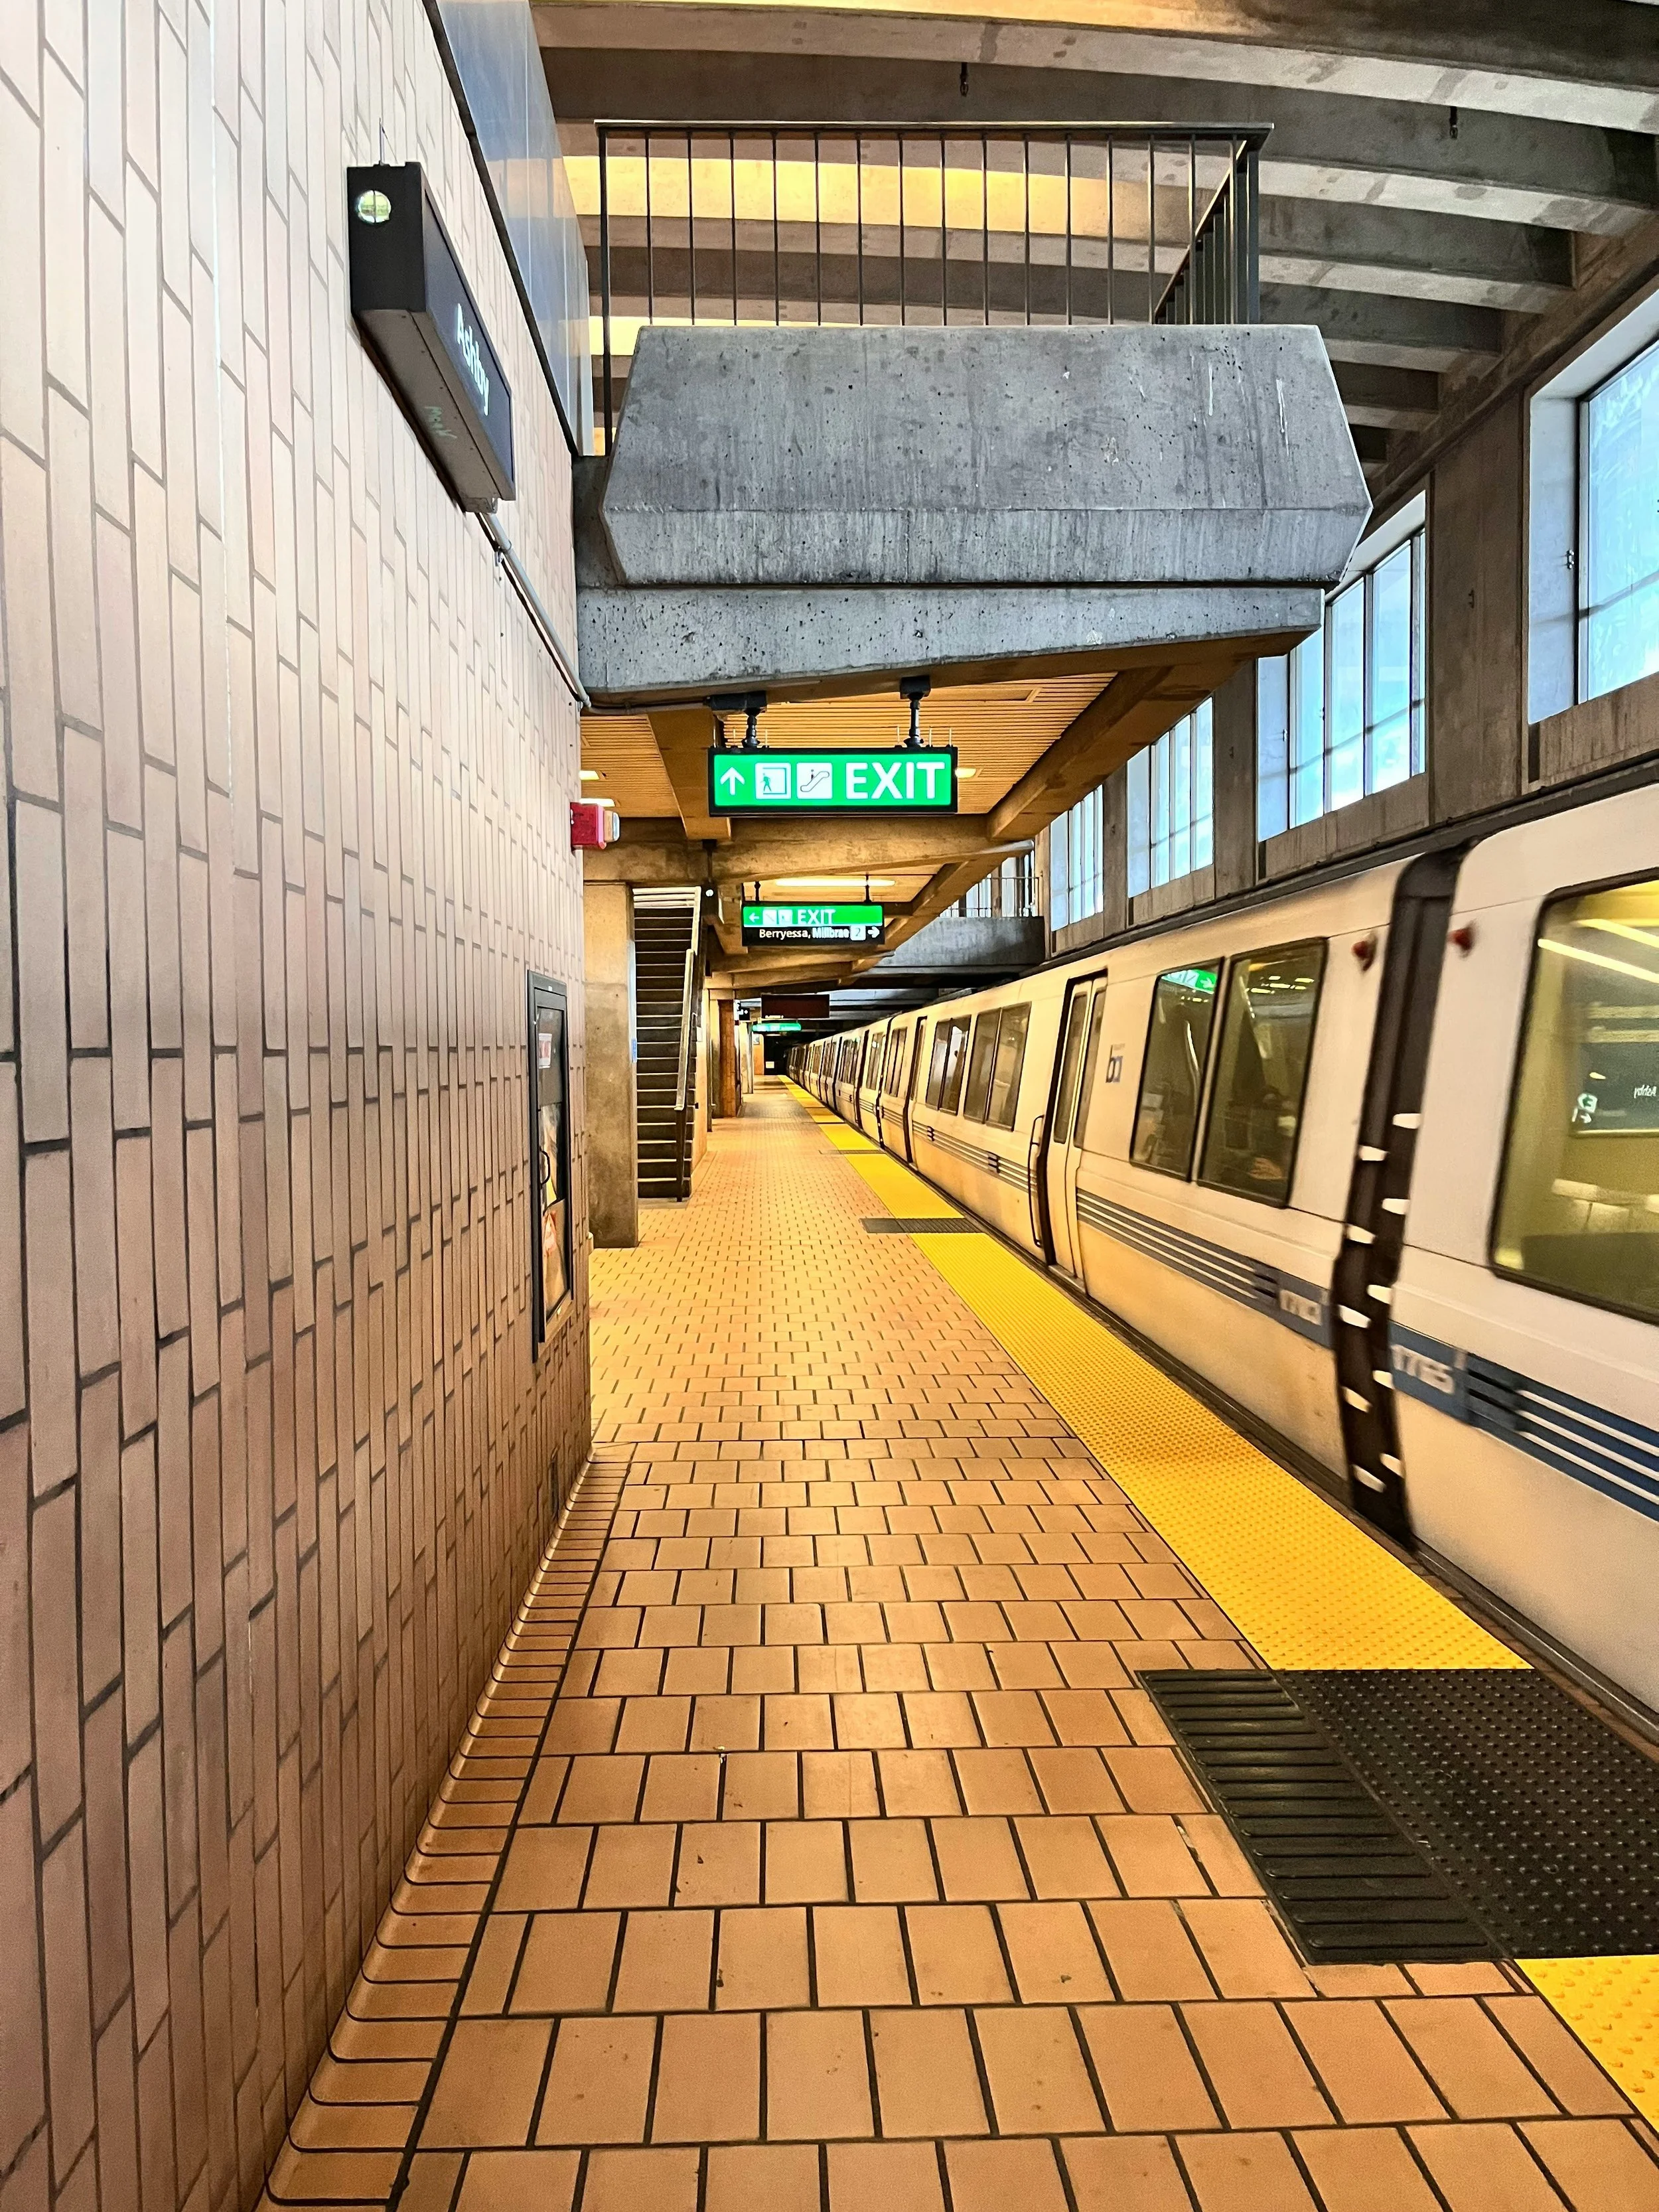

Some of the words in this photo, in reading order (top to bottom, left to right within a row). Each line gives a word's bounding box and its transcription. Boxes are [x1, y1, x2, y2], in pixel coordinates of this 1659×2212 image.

[457, 303, 490, 416] Ashby
[845, 762, 945, 799] EXIT
[798, 909, 836, 924] EXIT
[759, 929, 811, 940] Berryessa,
